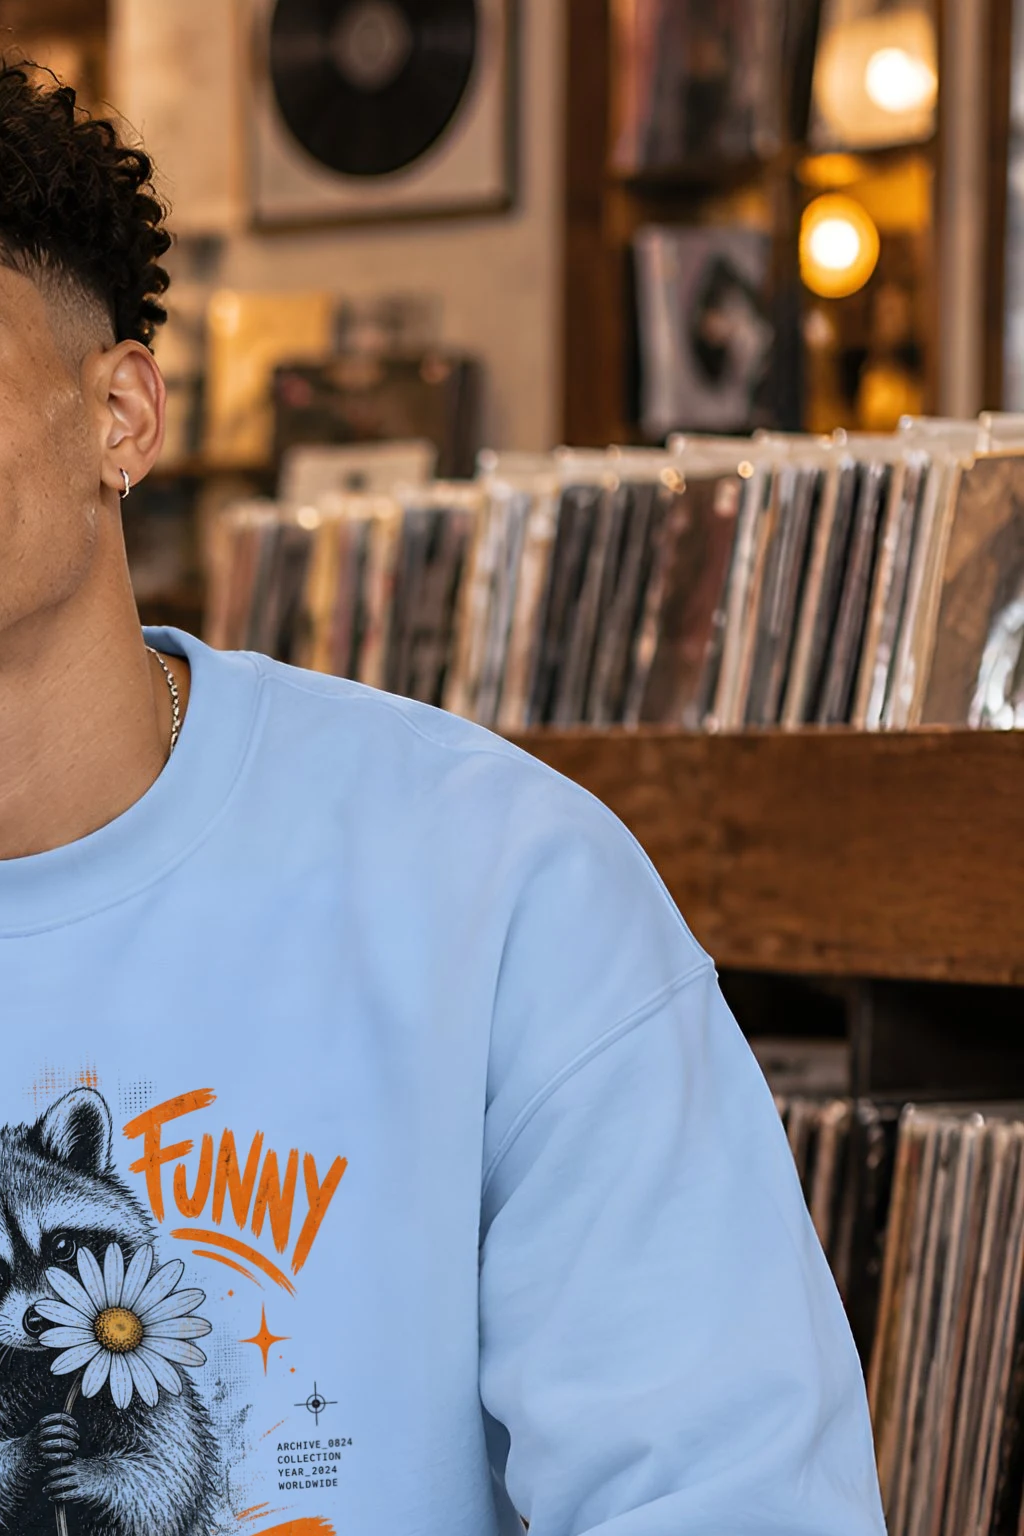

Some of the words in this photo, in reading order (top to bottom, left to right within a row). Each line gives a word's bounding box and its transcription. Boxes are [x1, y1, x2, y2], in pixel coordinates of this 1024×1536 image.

[122, 1087, 348, 1276] FUNNY
[277, 1438, 353, 1451] ARCHIVE_0824
[277, 1452, 342, 1464] COLLECTION
[278, 1466, 338, 1477] YEAR_2024
[278, 1478, 339, 1490] WORLDWIDE
